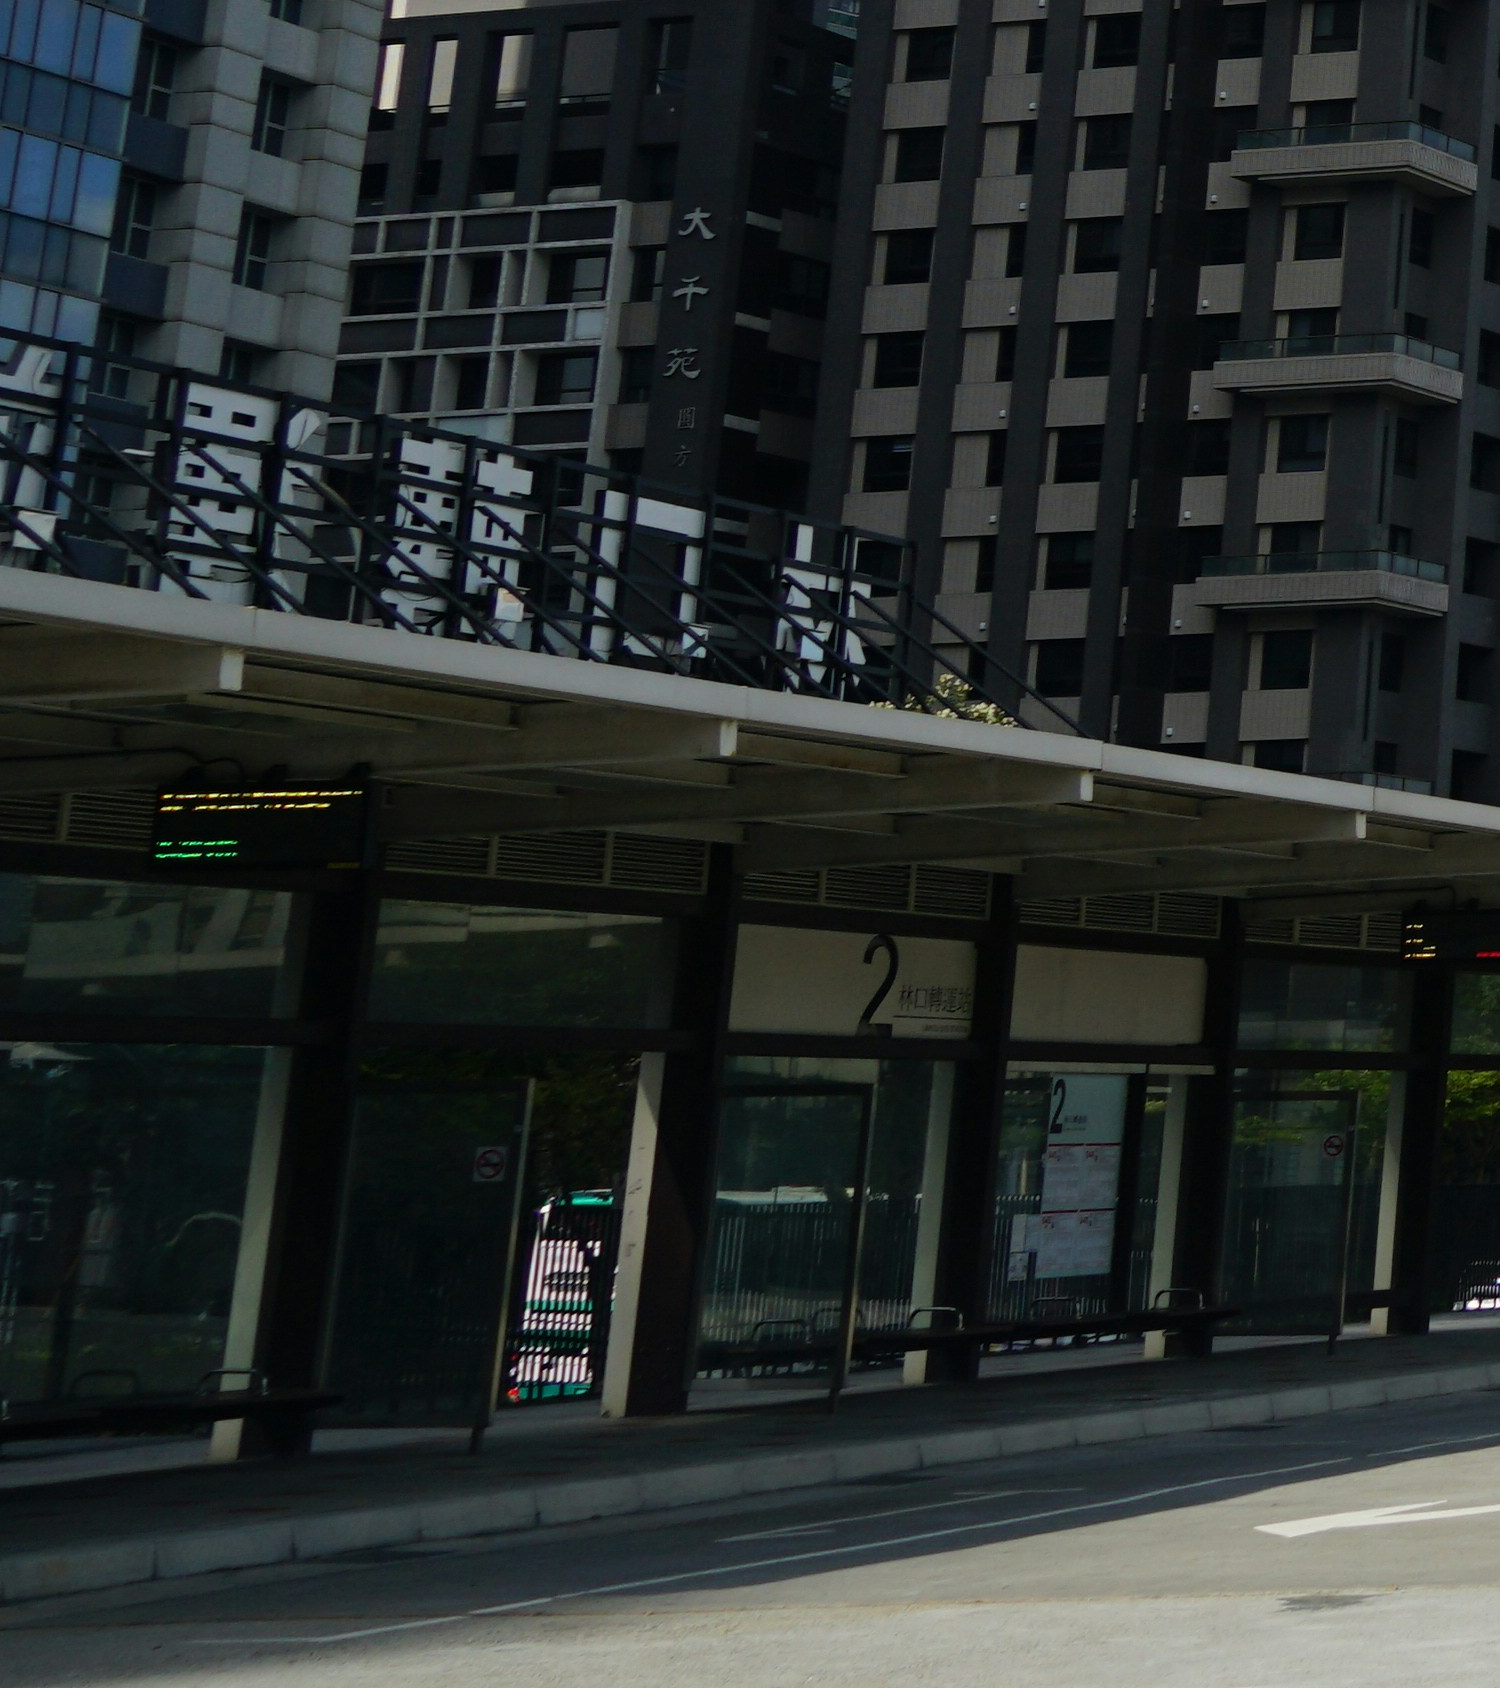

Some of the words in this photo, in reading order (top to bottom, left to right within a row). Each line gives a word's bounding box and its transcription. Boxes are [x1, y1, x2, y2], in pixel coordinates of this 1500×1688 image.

[663, 207, 716, 380] 大千苑
[855, 934, 898, 1037] 2
[1050, 1079, 1067, 1134] 2
